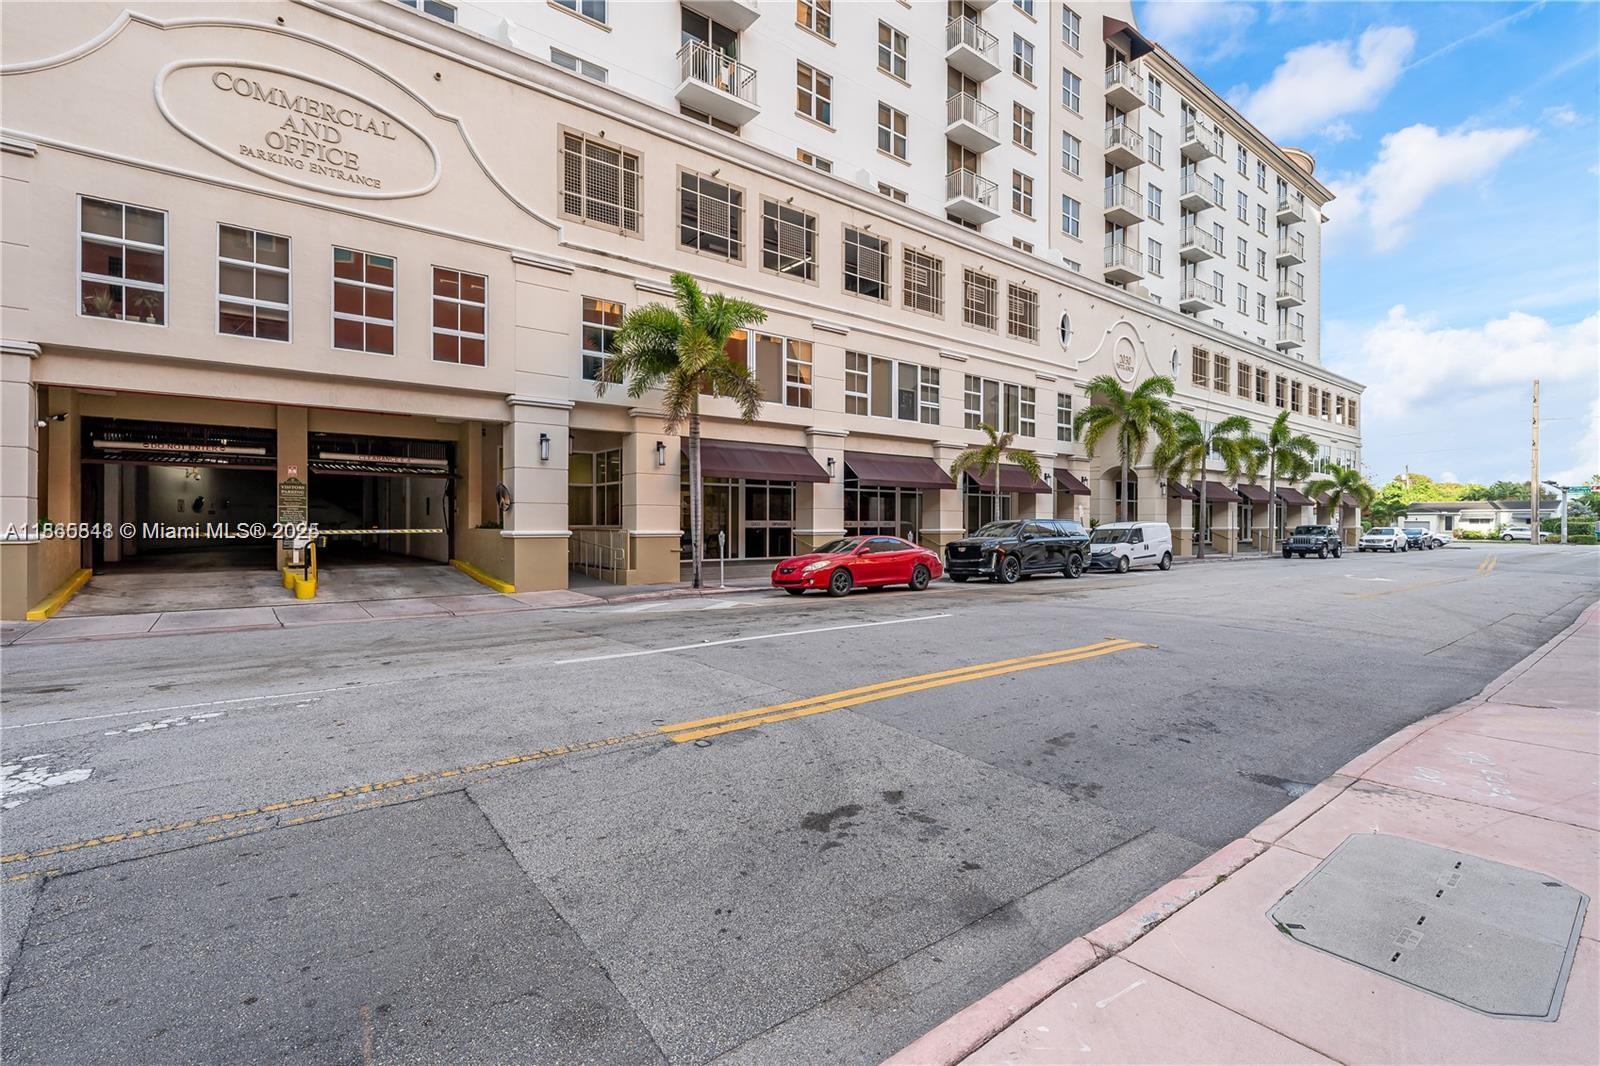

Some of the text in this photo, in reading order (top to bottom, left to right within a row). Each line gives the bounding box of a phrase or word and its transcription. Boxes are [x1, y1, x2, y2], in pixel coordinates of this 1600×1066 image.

[212, 71, 397, 141] COMMERCIAL
[280, 115, 342, 144] AND
[239, 144, 381, 189] PARKING ENTRANCE
[265, 131, 360, 171] OFFICE
